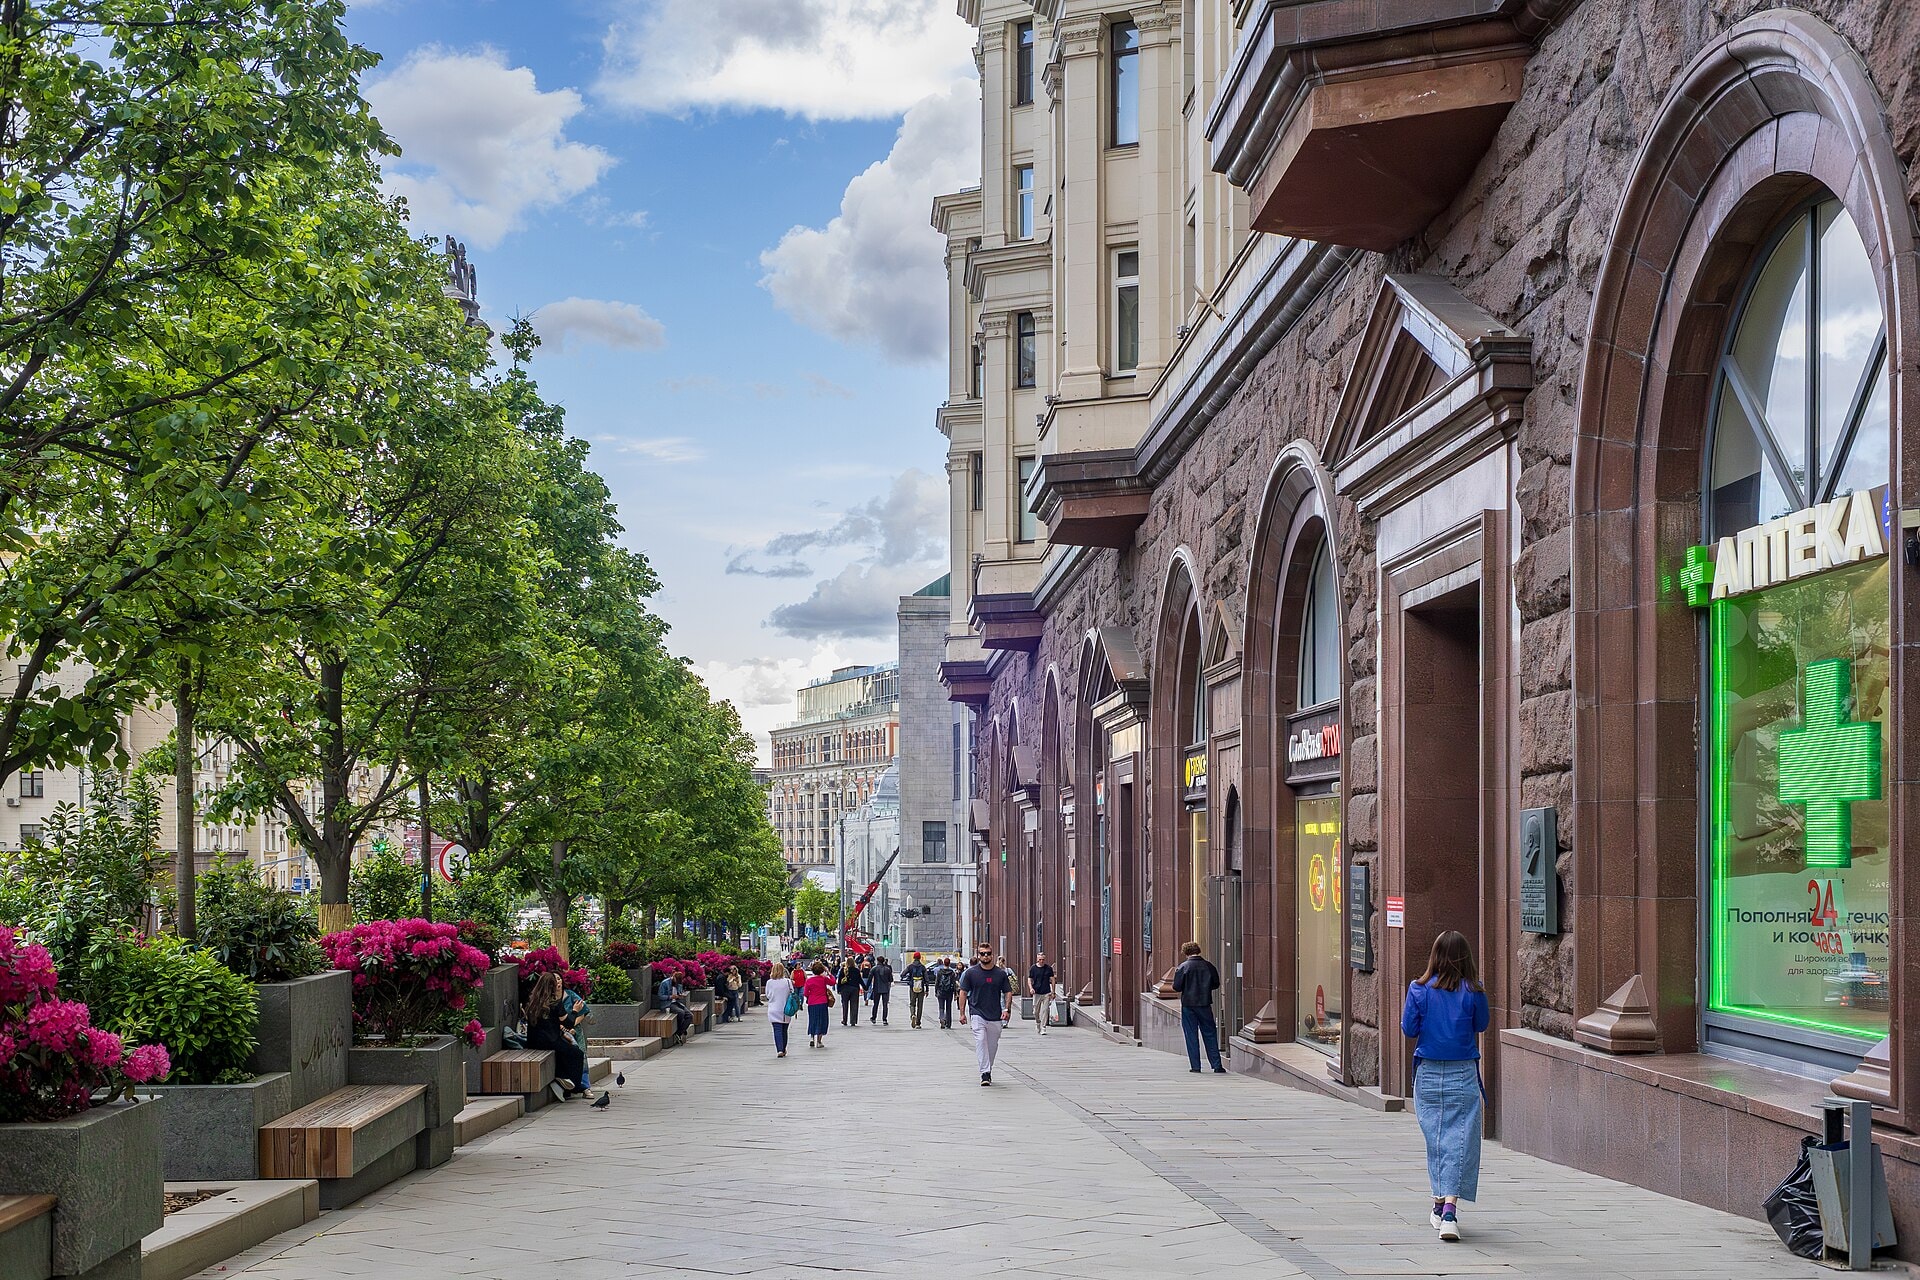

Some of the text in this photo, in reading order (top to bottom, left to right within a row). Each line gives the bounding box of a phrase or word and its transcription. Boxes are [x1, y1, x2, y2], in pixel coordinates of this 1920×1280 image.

[1712, 490, 1884, 600] АПТЕКА
[449, 853, 471, 871] 50
[1807, 879, 1838, 927] 24
[1773, 931, 1784, 943] и
[1812, 931, 1844, 955] часа
[1794, 954, 1836, 964] Широкий
[1788, 968, 1804, 976] для
